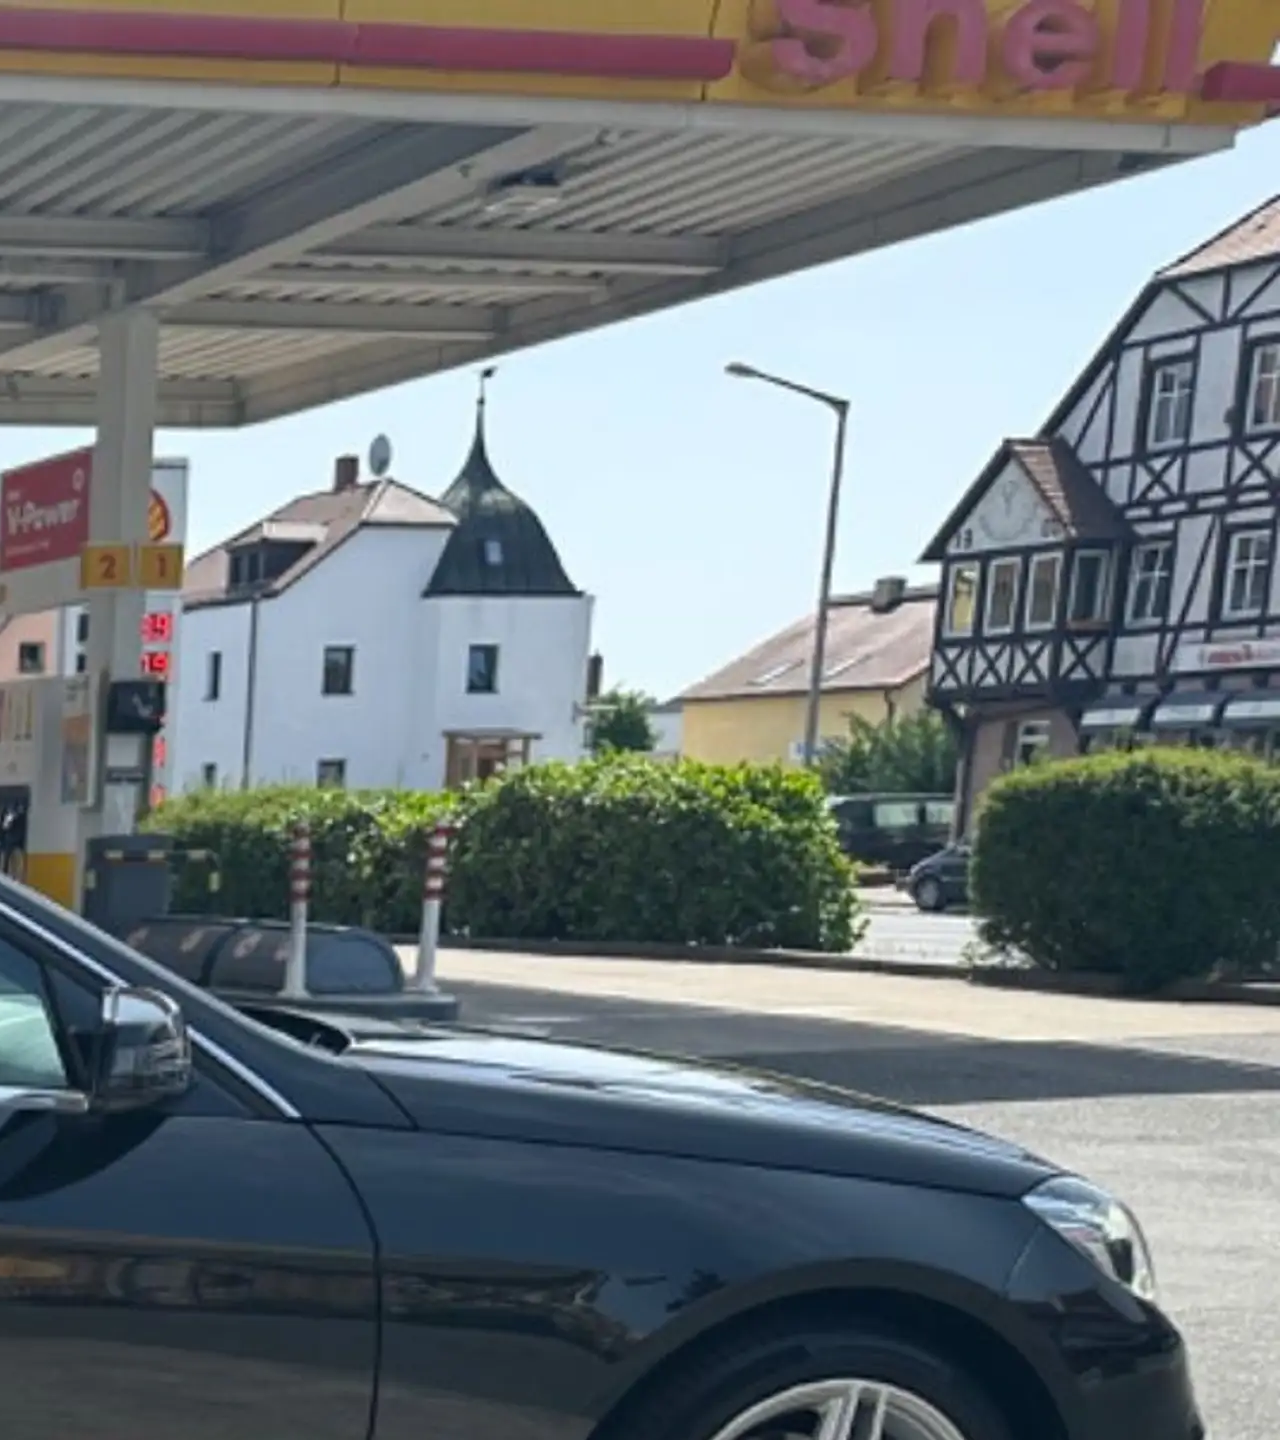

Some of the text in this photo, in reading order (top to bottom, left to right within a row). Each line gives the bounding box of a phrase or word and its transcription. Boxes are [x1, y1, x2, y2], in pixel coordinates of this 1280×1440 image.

[768, 0, 1204, 94] Shell
[6, 499, 81, 536] V-Power
[99, 555, 117, 580] 2
[157, 553, 167, 577] 1
